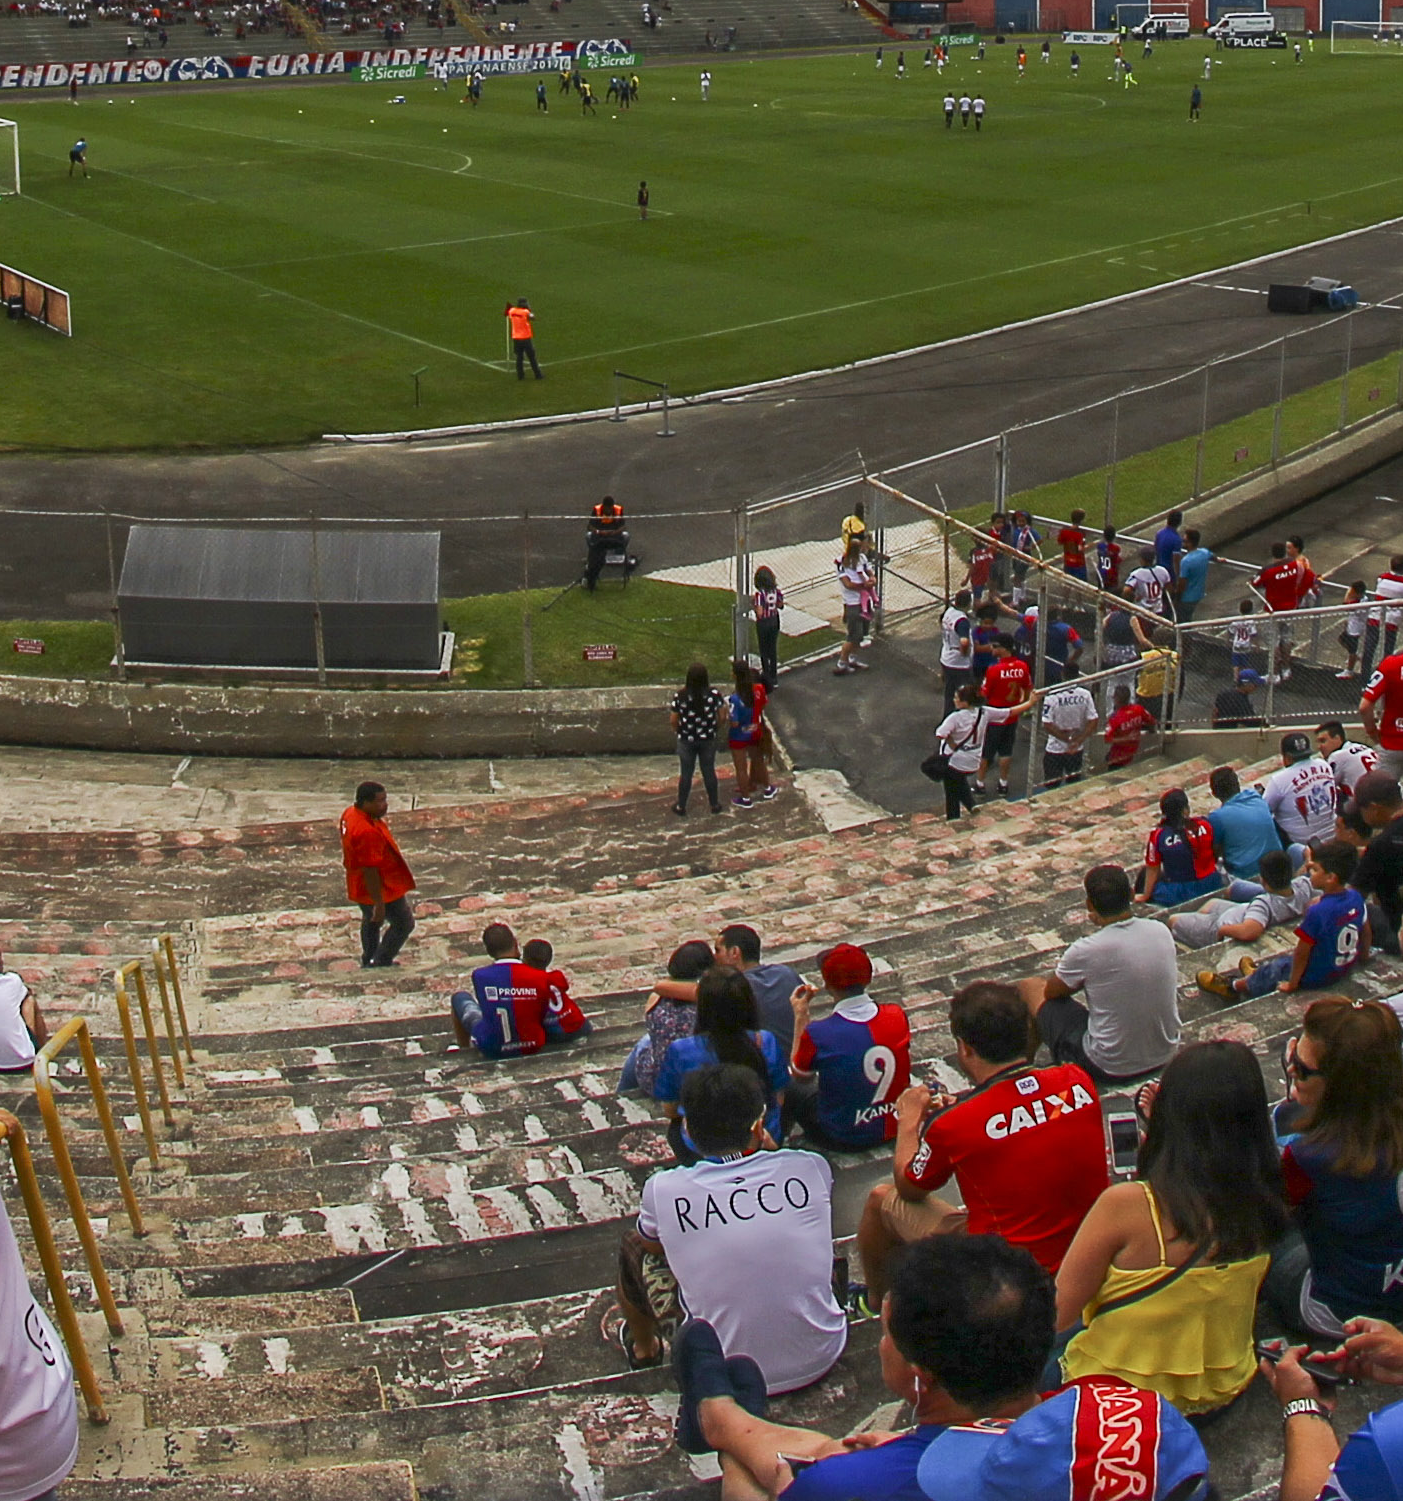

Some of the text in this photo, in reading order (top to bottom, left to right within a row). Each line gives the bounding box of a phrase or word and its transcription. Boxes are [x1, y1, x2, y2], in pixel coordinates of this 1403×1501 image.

[360, 41, 563, 67] INDEPENDENTE
[599, 53, 635, 67] Sicredi
[376, 65, 417, 80] Sicredi
[448, 57, 560, 74] PARANAENSE 2017
[1147, 581, 1161, 598] 10
[1000, 668, 1025, 679] RACCO
[1058, 696, 1085, 707] RACCO
[1291, 766, 1332, 786] FÚRIA
[1335, 925, 1359, 966] 9
[862, 1044, 897, 1102] 9
[985, 1083, 1094, 1141] CAIXA
[674, 1177, 810, 1233] RACCO
